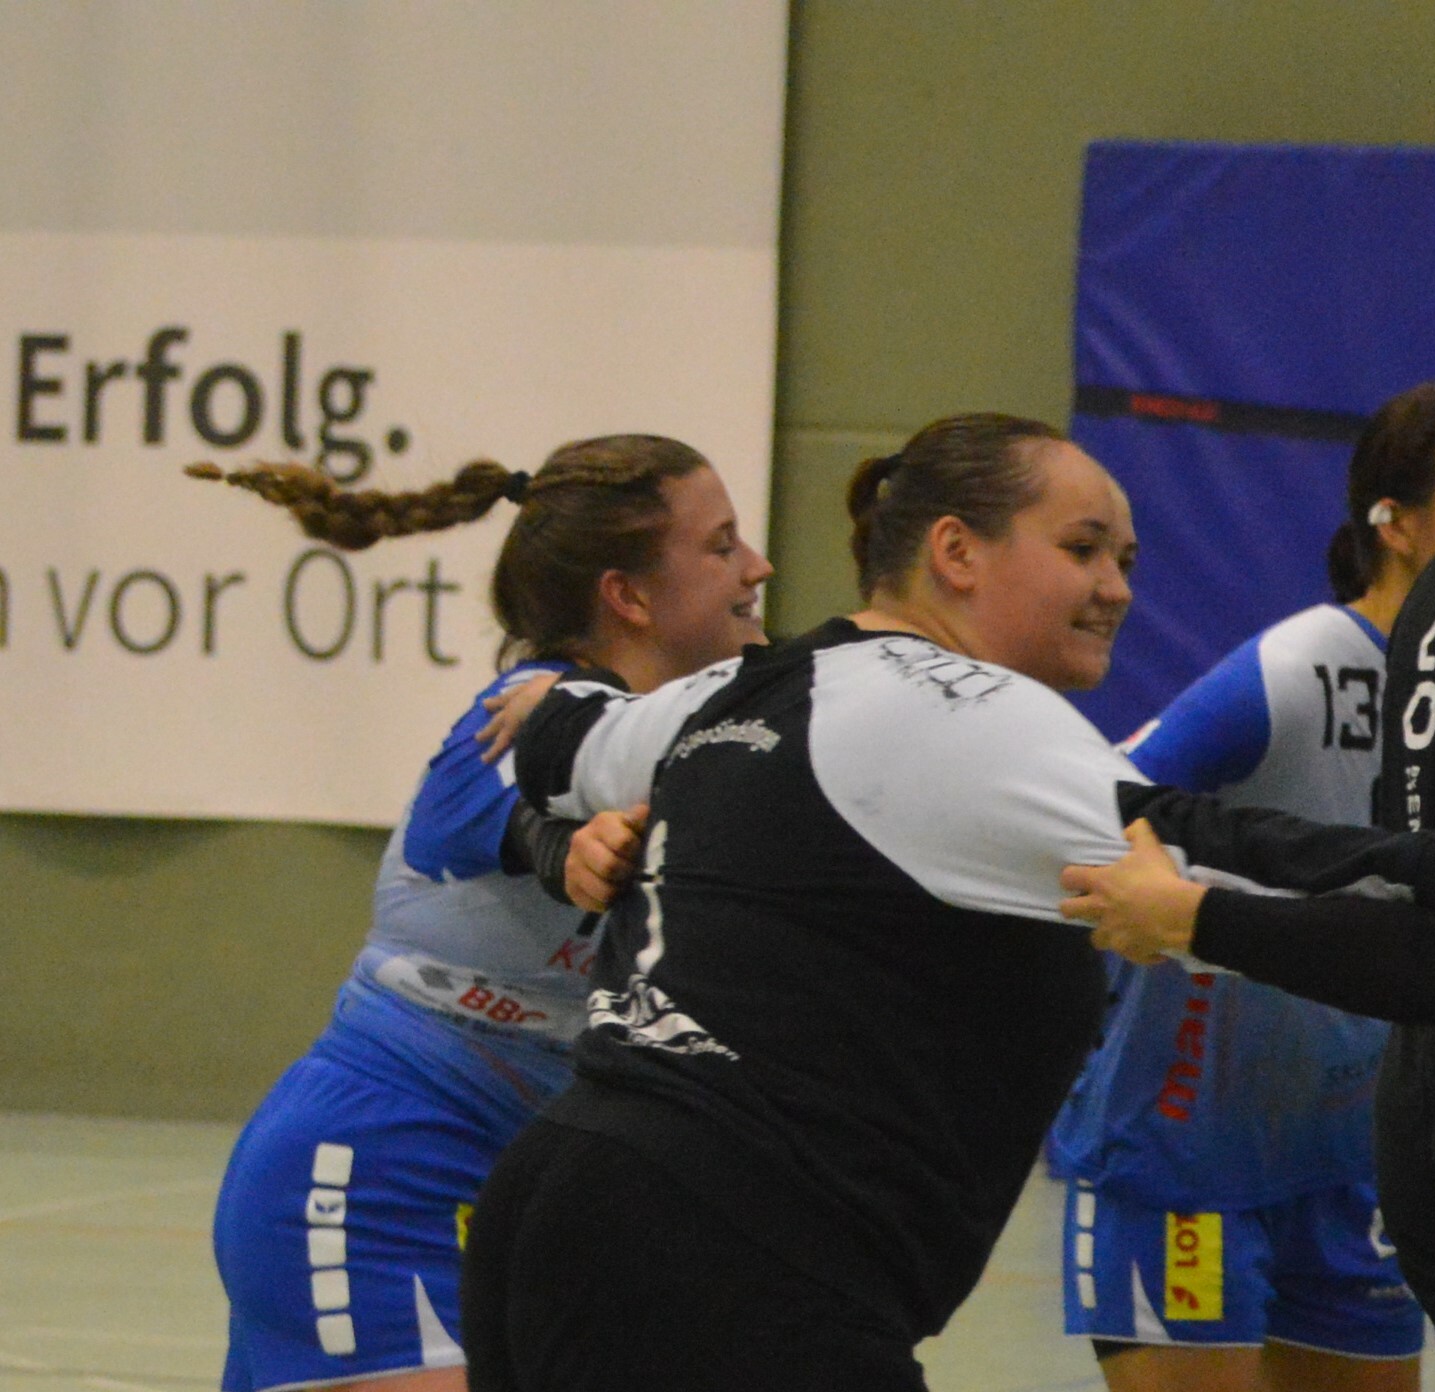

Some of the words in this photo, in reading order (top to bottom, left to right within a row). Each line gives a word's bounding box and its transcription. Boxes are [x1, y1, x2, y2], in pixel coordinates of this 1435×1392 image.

[16, 326, 412, 483] Erfolg.
[47, 567, 247, 656] vor
[284, 547, 461, 668] Ort
[1313, 662, 1380, 752] 13
